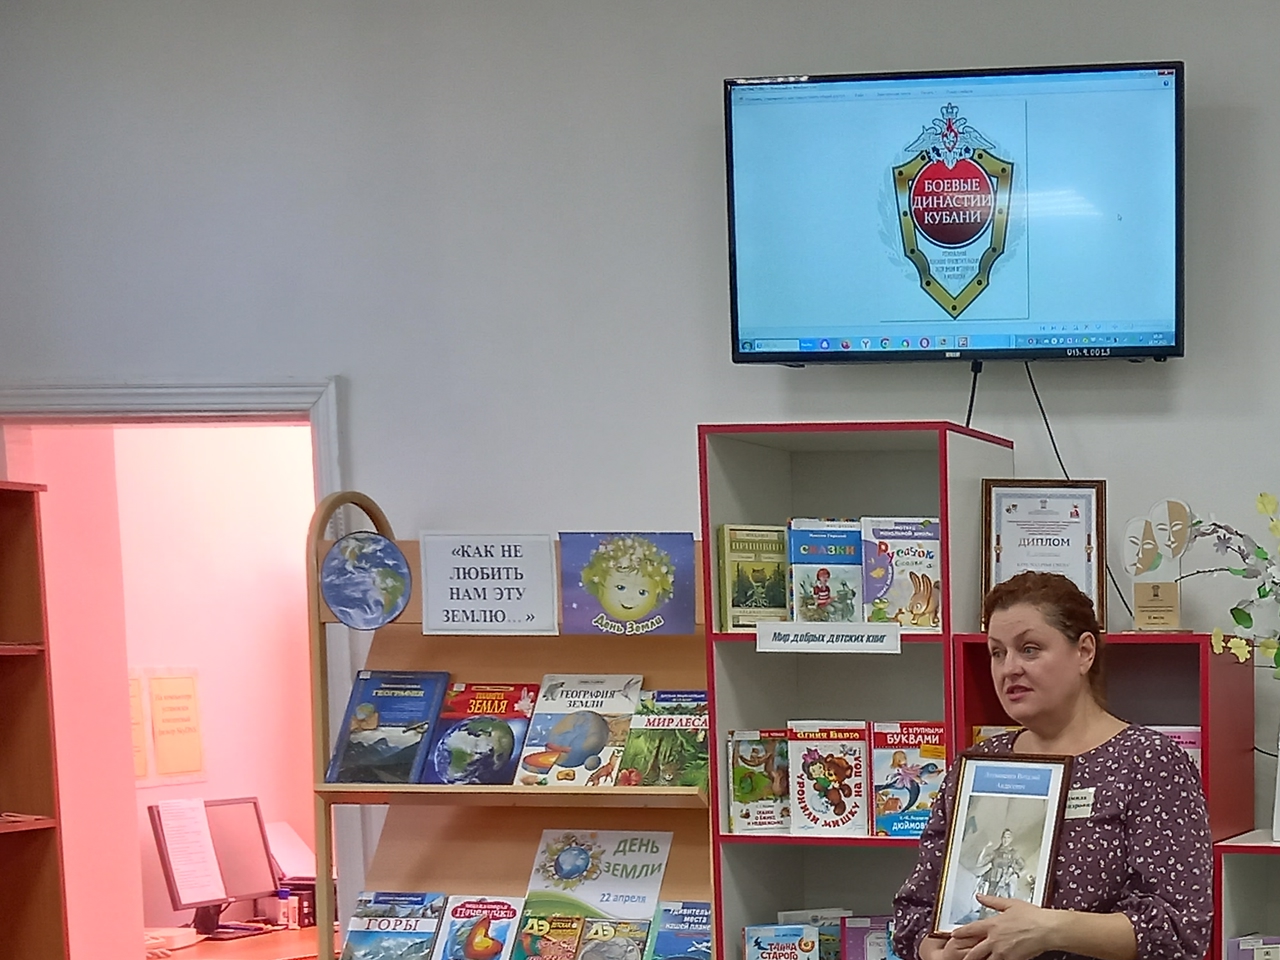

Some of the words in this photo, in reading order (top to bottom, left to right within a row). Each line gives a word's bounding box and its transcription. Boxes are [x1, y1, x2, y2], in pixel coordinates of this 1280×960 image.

[924, 178, 980, 193] БОЕВЫЕ
[912, 194, 992, 211] ДИНАСТИИ
[924, 210, 981, 225] КУБАНИ
[1017, 537, 1070, 548] ДИПЛОМ
[451, 544, 495, 558] «КАК
[501, 544, 523, 558] НЕ
[800, 544, 855, 556] СКАЗКИ
[449, 566, 524, 580] ЛЮБИТЬ
[449, 587, 487, 600] НАМ
[493, 587, 526, 601] ЭТУ
[593, 613, 624, 633] День
[625, 616, 664, 634] Земли
[772, 632, 789, 643] Мир
[789, 634, 825, 644] добрых
[828, 633, 865, 644] детских
[866, 634, 886, 643] книг
[559, 689, 617, 699] ГЕОГРАФИЯ
[467, 700, 507, 713] ЗЕМЛЯ
[566, 700, 604, 708] ЗЕМЛИ
[644, 717, 674, 728] МИР
[675, 717, 709, 728] ЛЕСА
[829, 730, 859, 740] Барто
[886, 734, 940, 745] БУКВАМИ
[612, 837, 660, 857] ДЕНЬ
[603, 861, 663, 880] ЗЕМЛИ
[599, 892, 612, 902] 22
[612, 893, 647, 904] апреля
[365, 918, 420, 931] ГОРЫ
[683, 916, 707, 924] места
[522, 918, 550, 936] ДЭ
[586, 923, 616, 941] ДЭ
[767, 942, 798, 951] ТАЙНА
[760, 951, 799, 960] СТАРОГО
